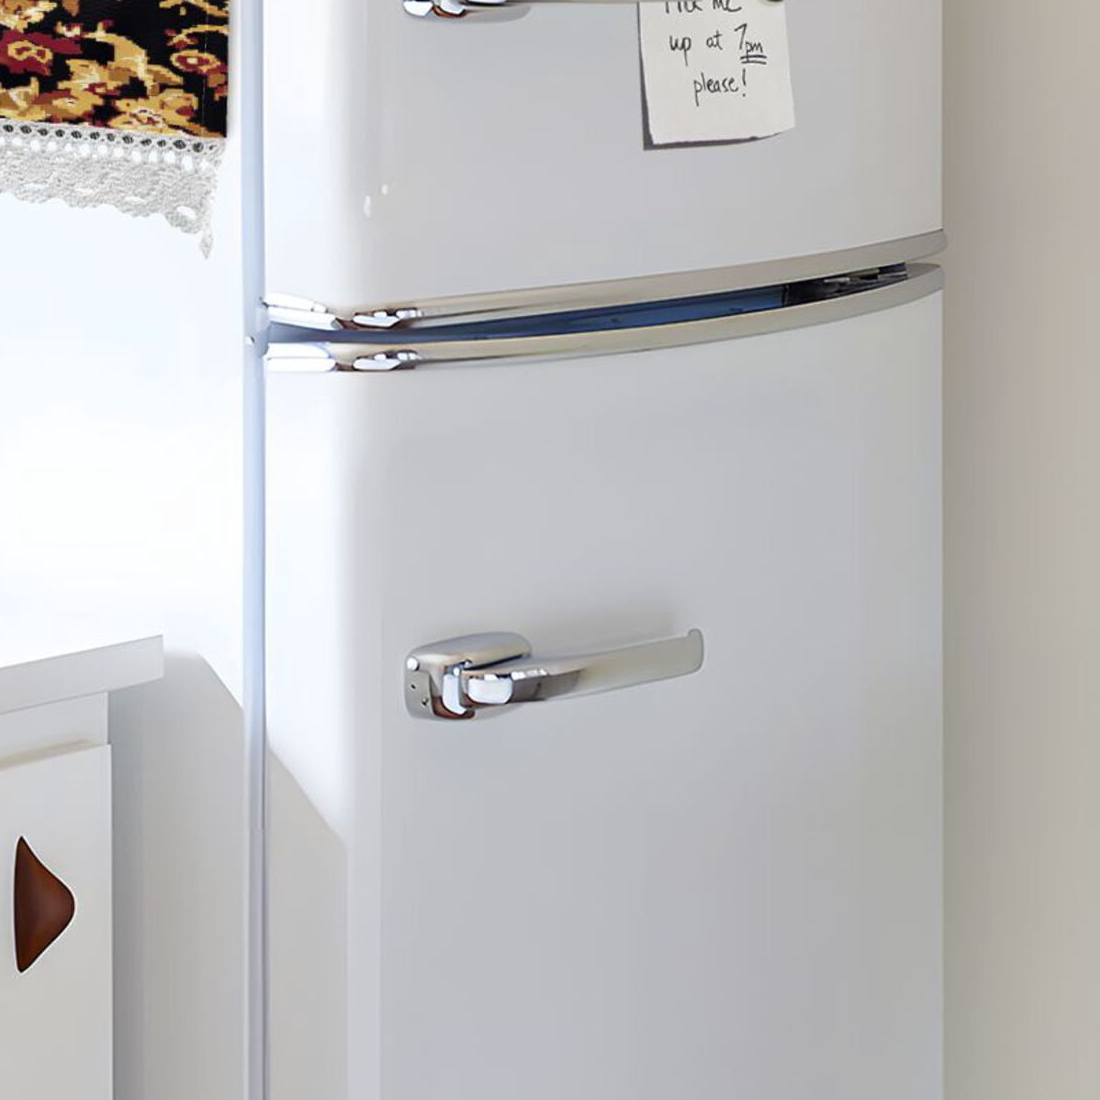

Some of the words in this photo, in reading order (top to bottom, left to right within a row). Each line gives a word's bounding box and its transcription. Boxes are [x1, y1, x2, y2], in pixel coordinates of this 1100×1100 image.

[669, 35, 692, 66] up
[706, 29, 723, 50] at
[693, 68, 747, 107] please!
